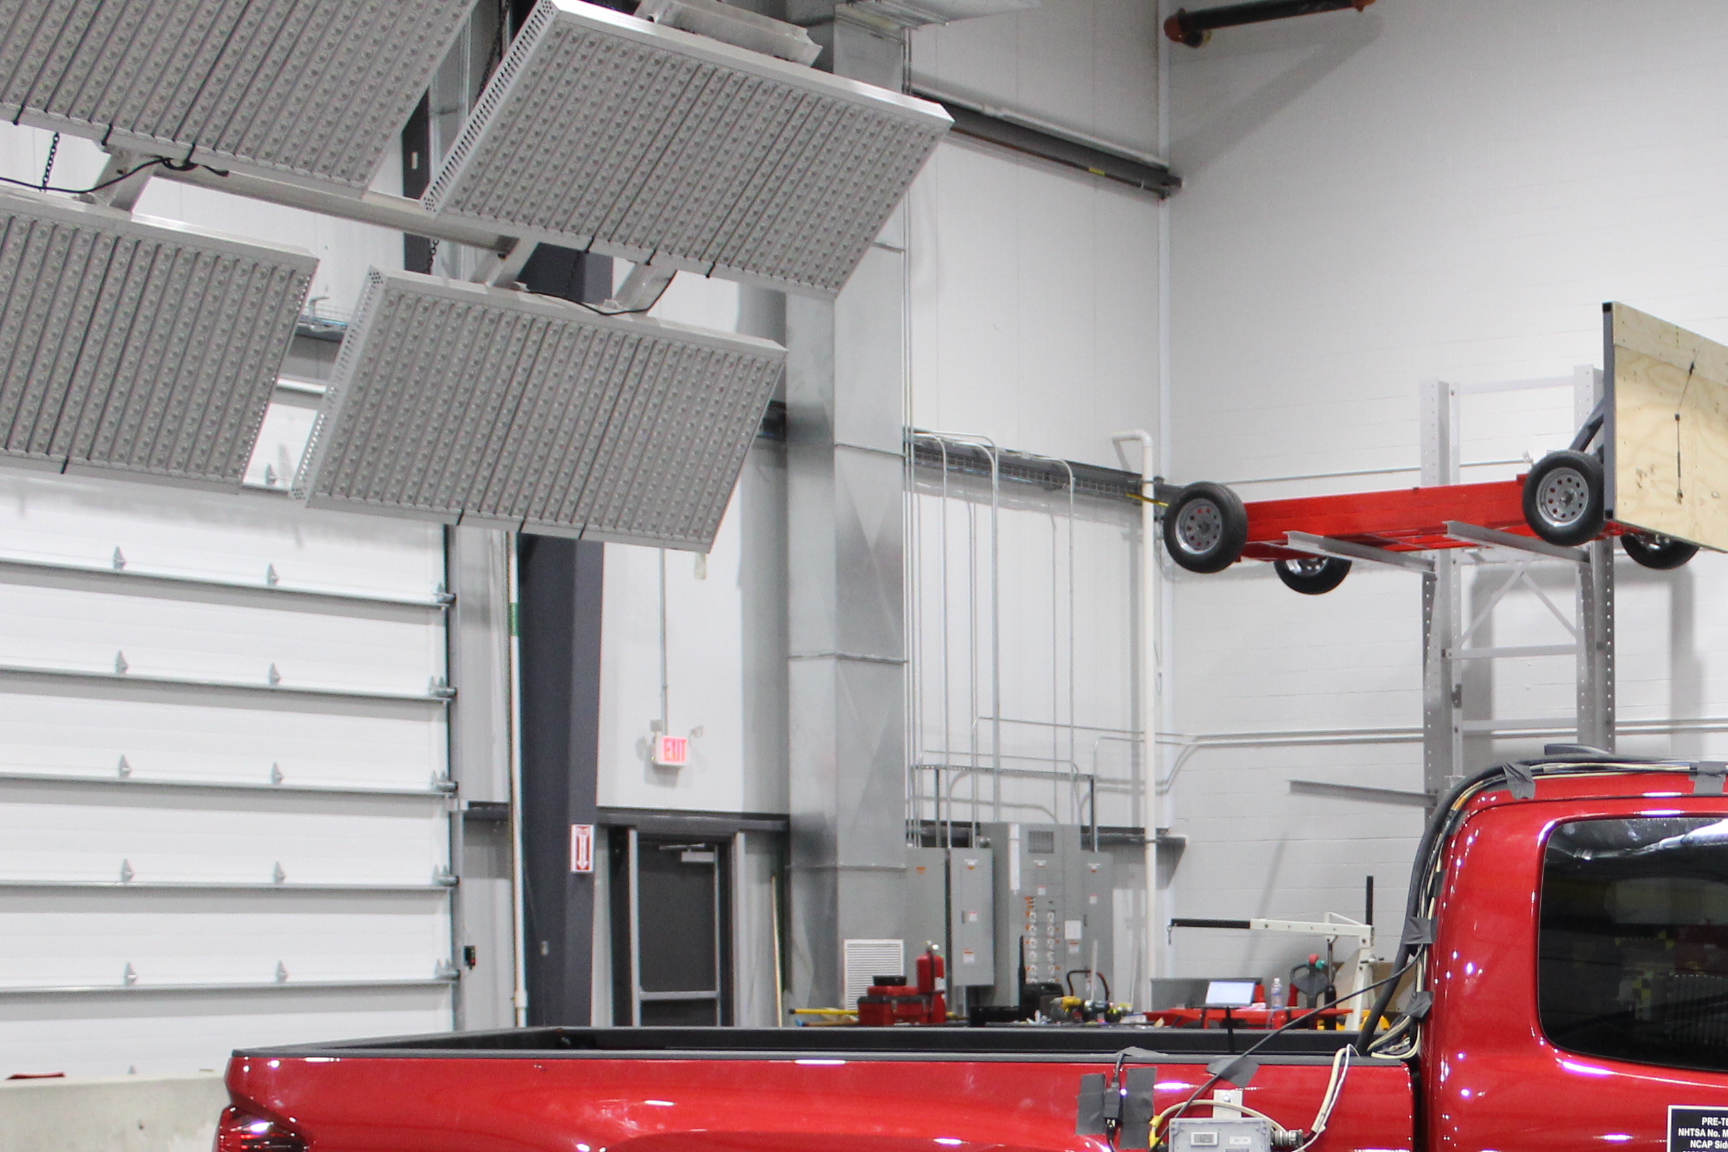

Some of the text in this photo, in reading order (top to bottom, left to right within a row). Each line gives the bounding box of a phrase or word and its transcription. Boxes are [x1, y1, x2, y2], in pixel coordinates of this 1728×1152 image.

[663, 738, 687, 762] EXIT
[1678, 1128, 1706, 1137] NHTSA
[1707, 1129, 1720, 1138] No.
[1690, 1140, 1713, 1148] NCAP
